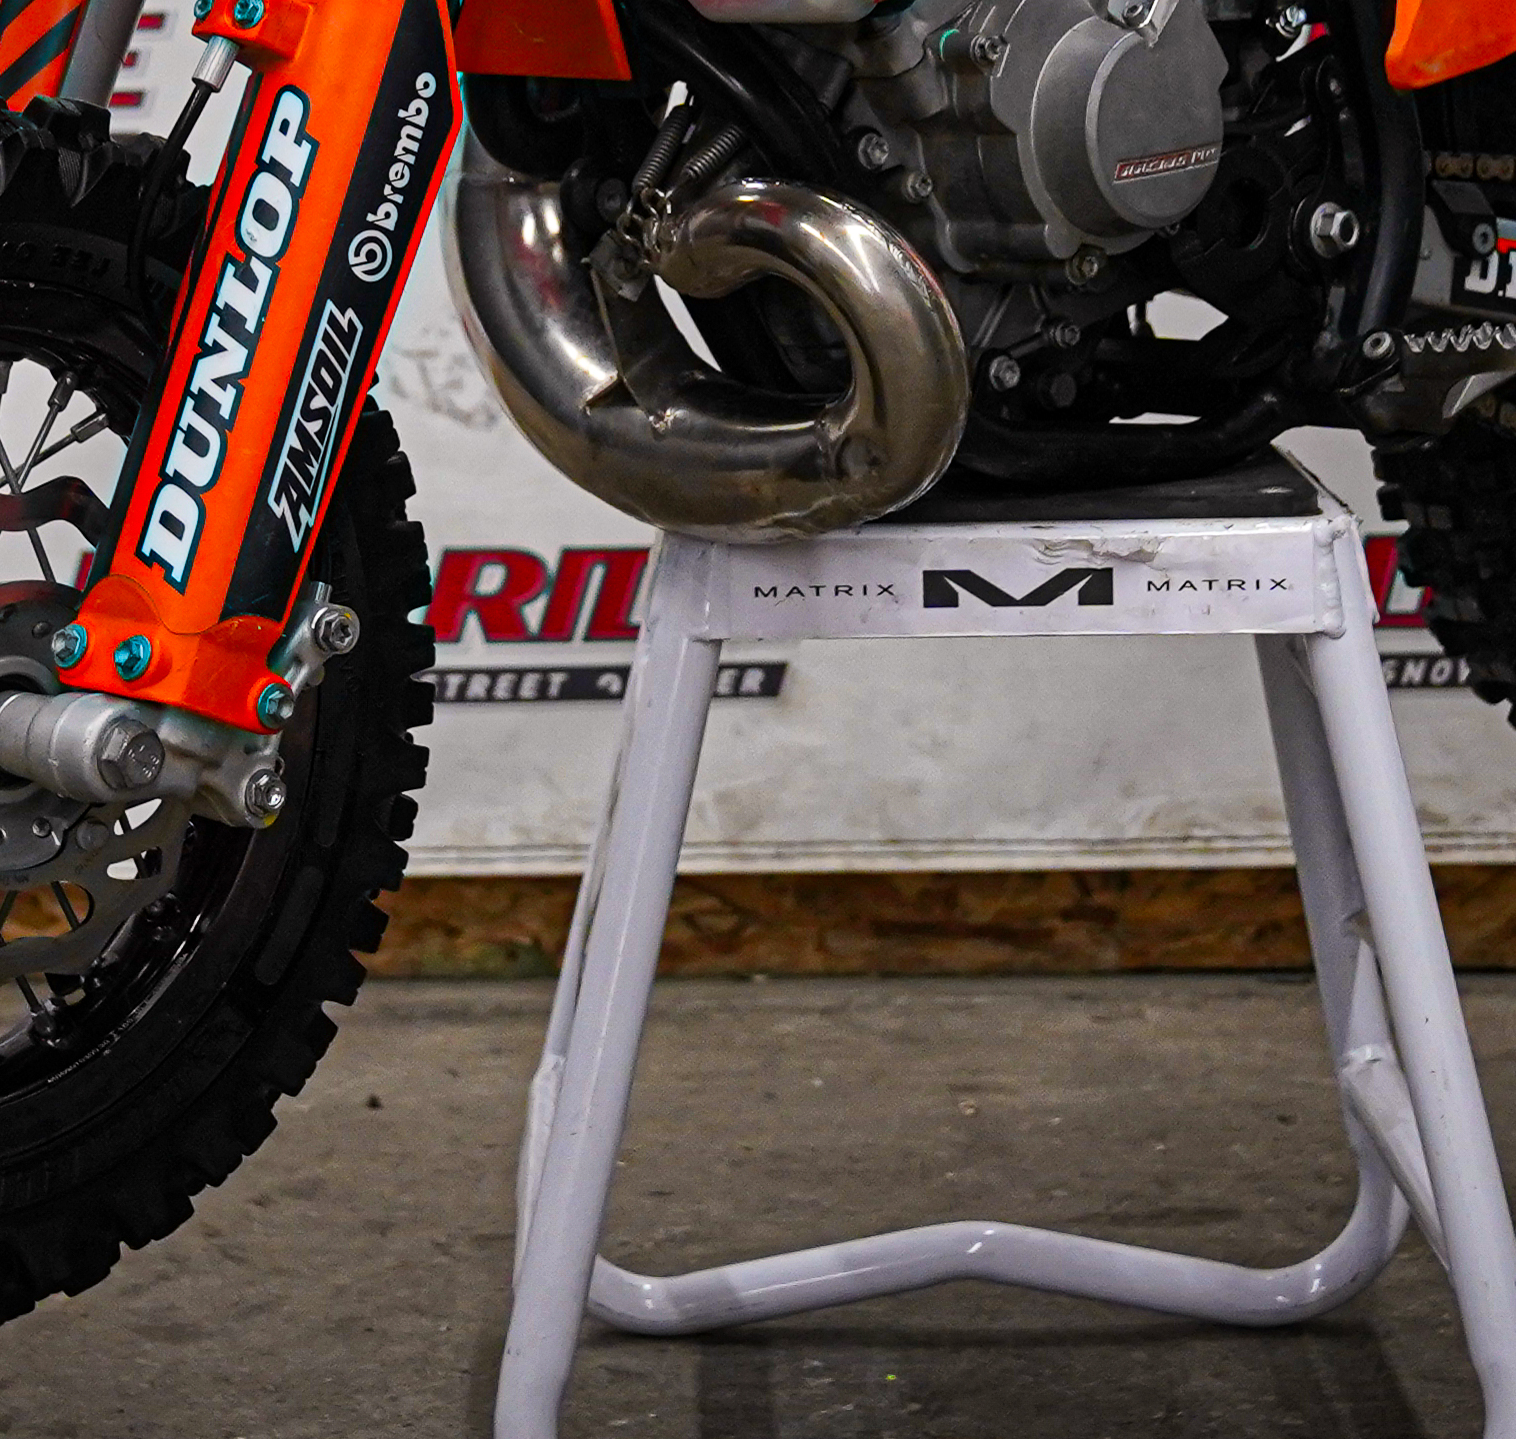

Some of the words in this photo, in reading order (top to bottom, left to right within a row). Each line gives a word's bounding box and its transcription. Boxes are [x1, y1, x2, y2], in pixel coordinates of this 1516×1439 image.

[366, 72, 436, 228] brembo
[139, 87, 315, 590] DUNLOP
[268, 300, 363, 553] AMSOIL
[754, 583, 896, 599] MATRIX
[1146, 577, 1288, 593] MATRIX
